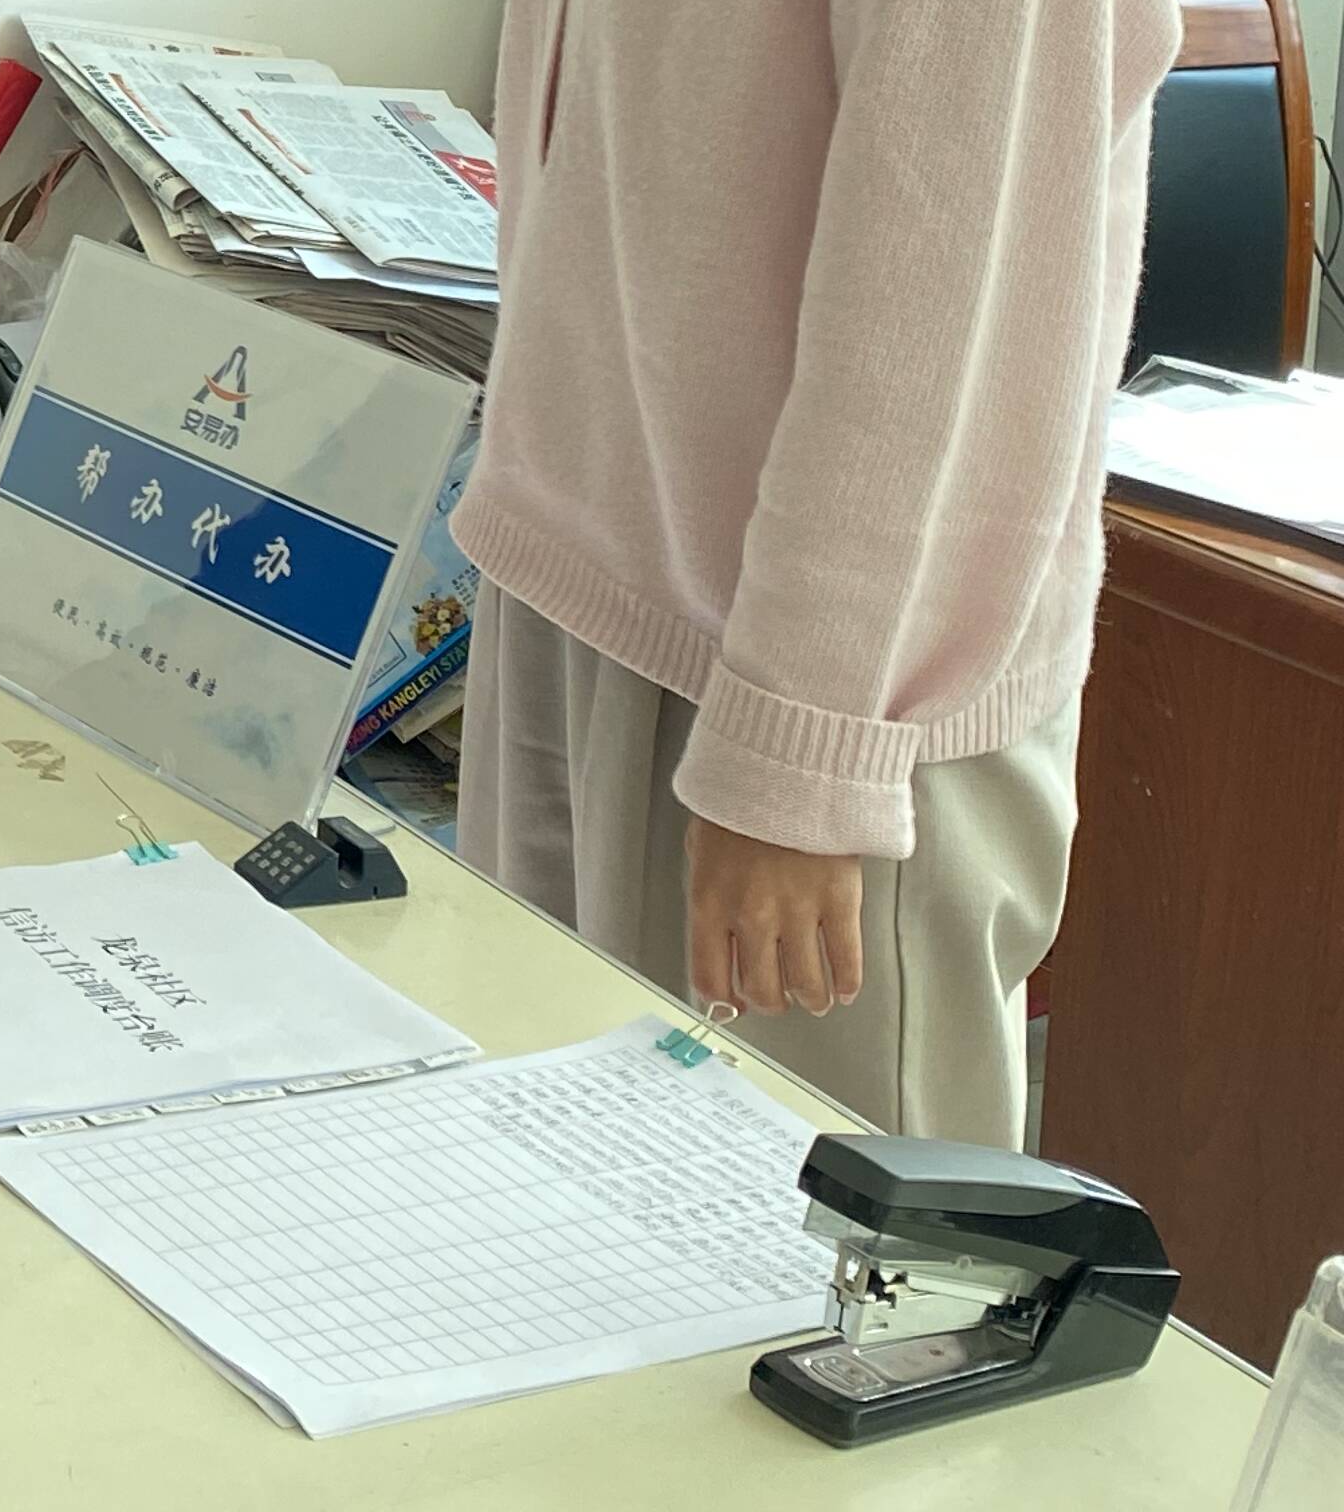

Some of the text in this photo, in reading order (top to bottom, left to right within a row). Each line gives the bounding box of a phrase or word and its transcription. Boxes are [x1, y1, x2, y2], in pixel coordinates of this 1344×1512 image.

[179, 407, 241, 451] 安易办
[75, 443, 293, 585] 帮办代办
[377, 666, 444, 721] KANGLEYI
[90, 933, 208, 1009] 龙泉社区
